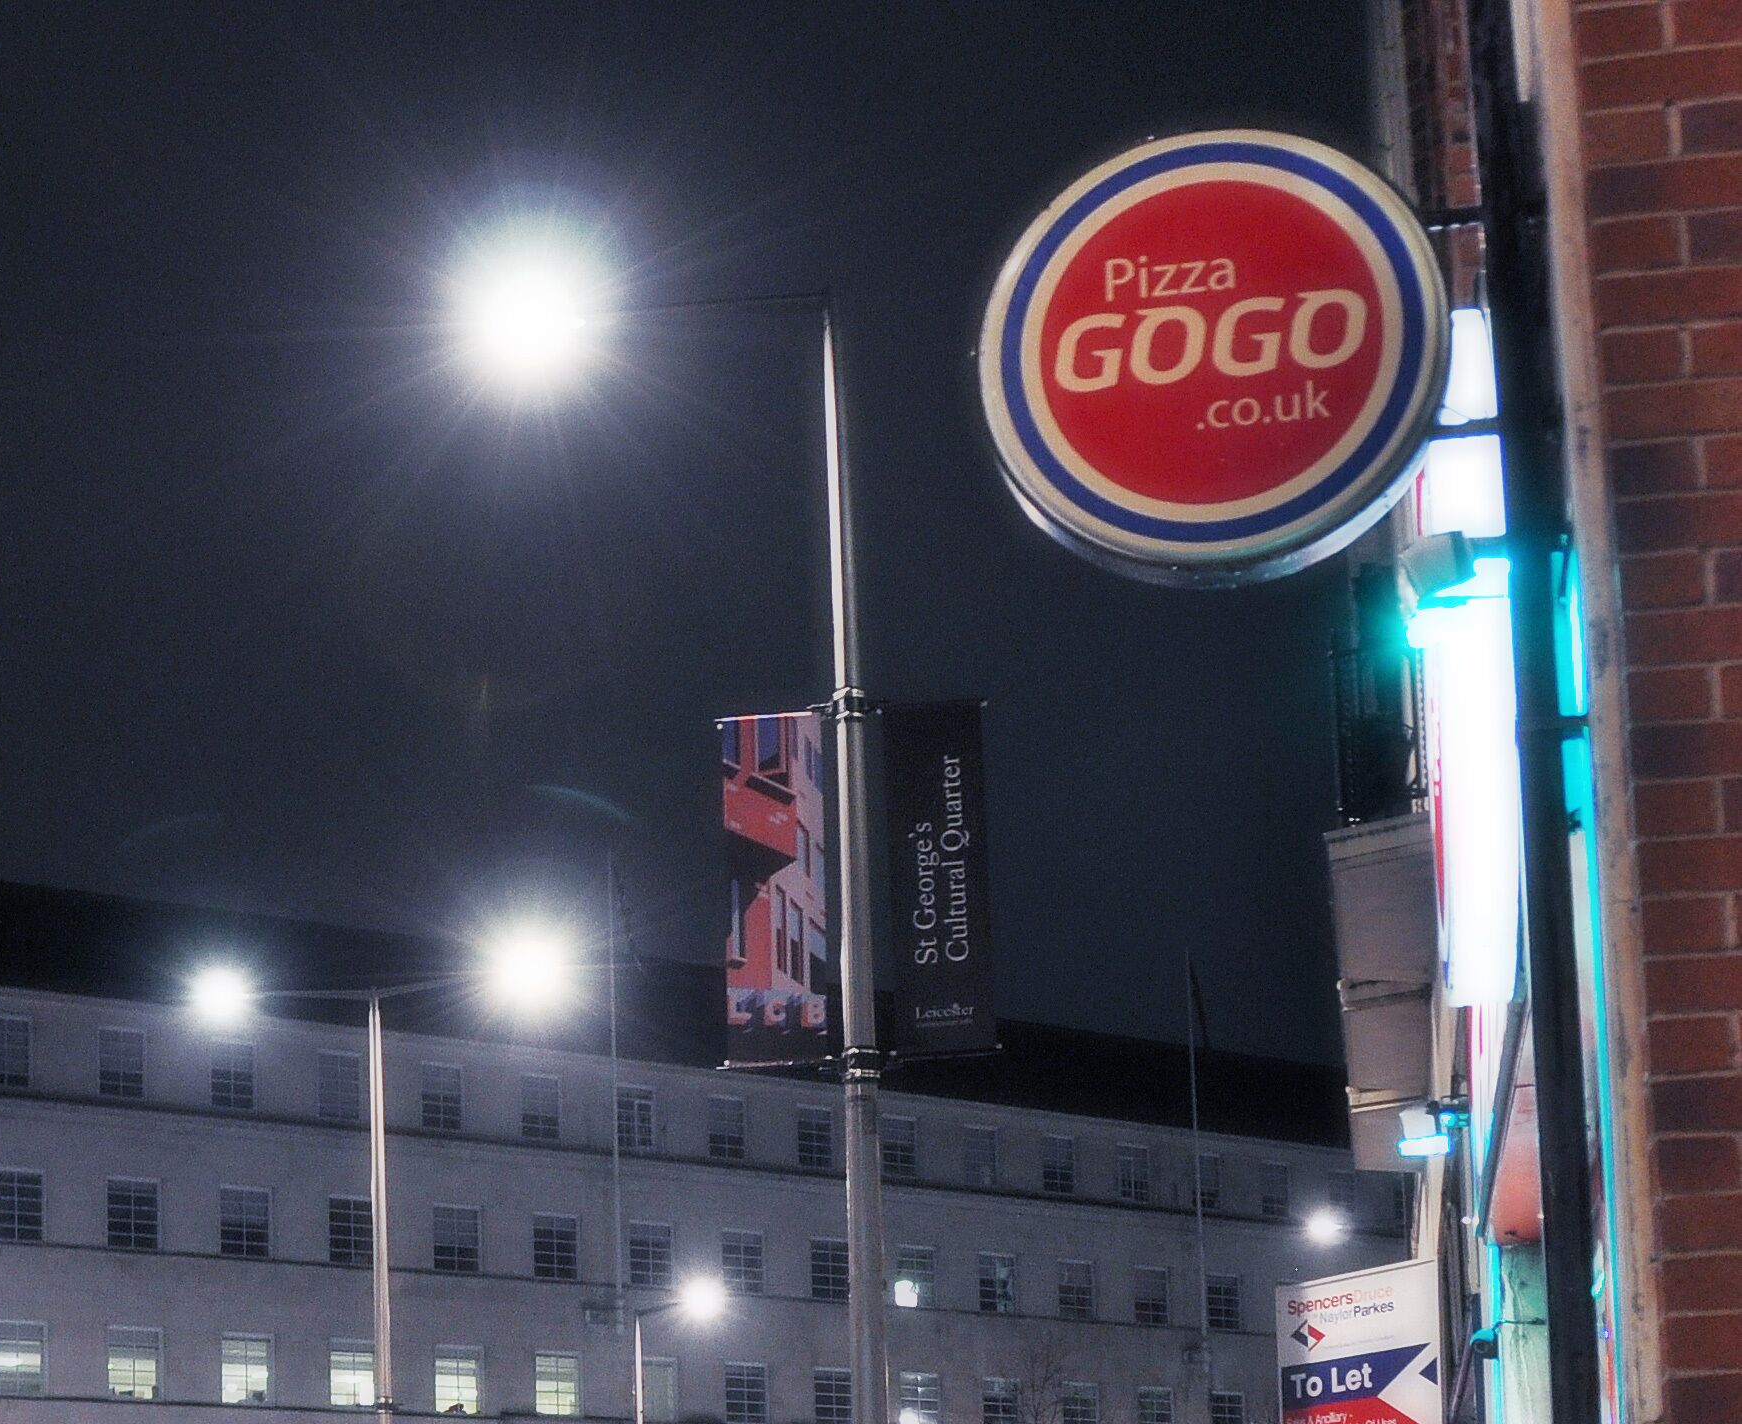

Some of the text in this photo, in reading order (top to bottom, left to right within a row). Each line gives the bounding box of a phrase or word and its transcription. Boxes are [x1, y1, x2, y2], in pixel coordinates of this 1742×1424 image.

[1105, 256, 1237, 302] Pizza
[1055, 288, 1369, 393] GOGO
[1196, 379, 1331, 431] .co.uk
[940, 755, 971, 962] Cultural Quarter
[909, 822, 940, 964] St George's
[1290, 1362, 1373, 1399] To Let
[1315, 1412, 1348, 1424] Ancillary
